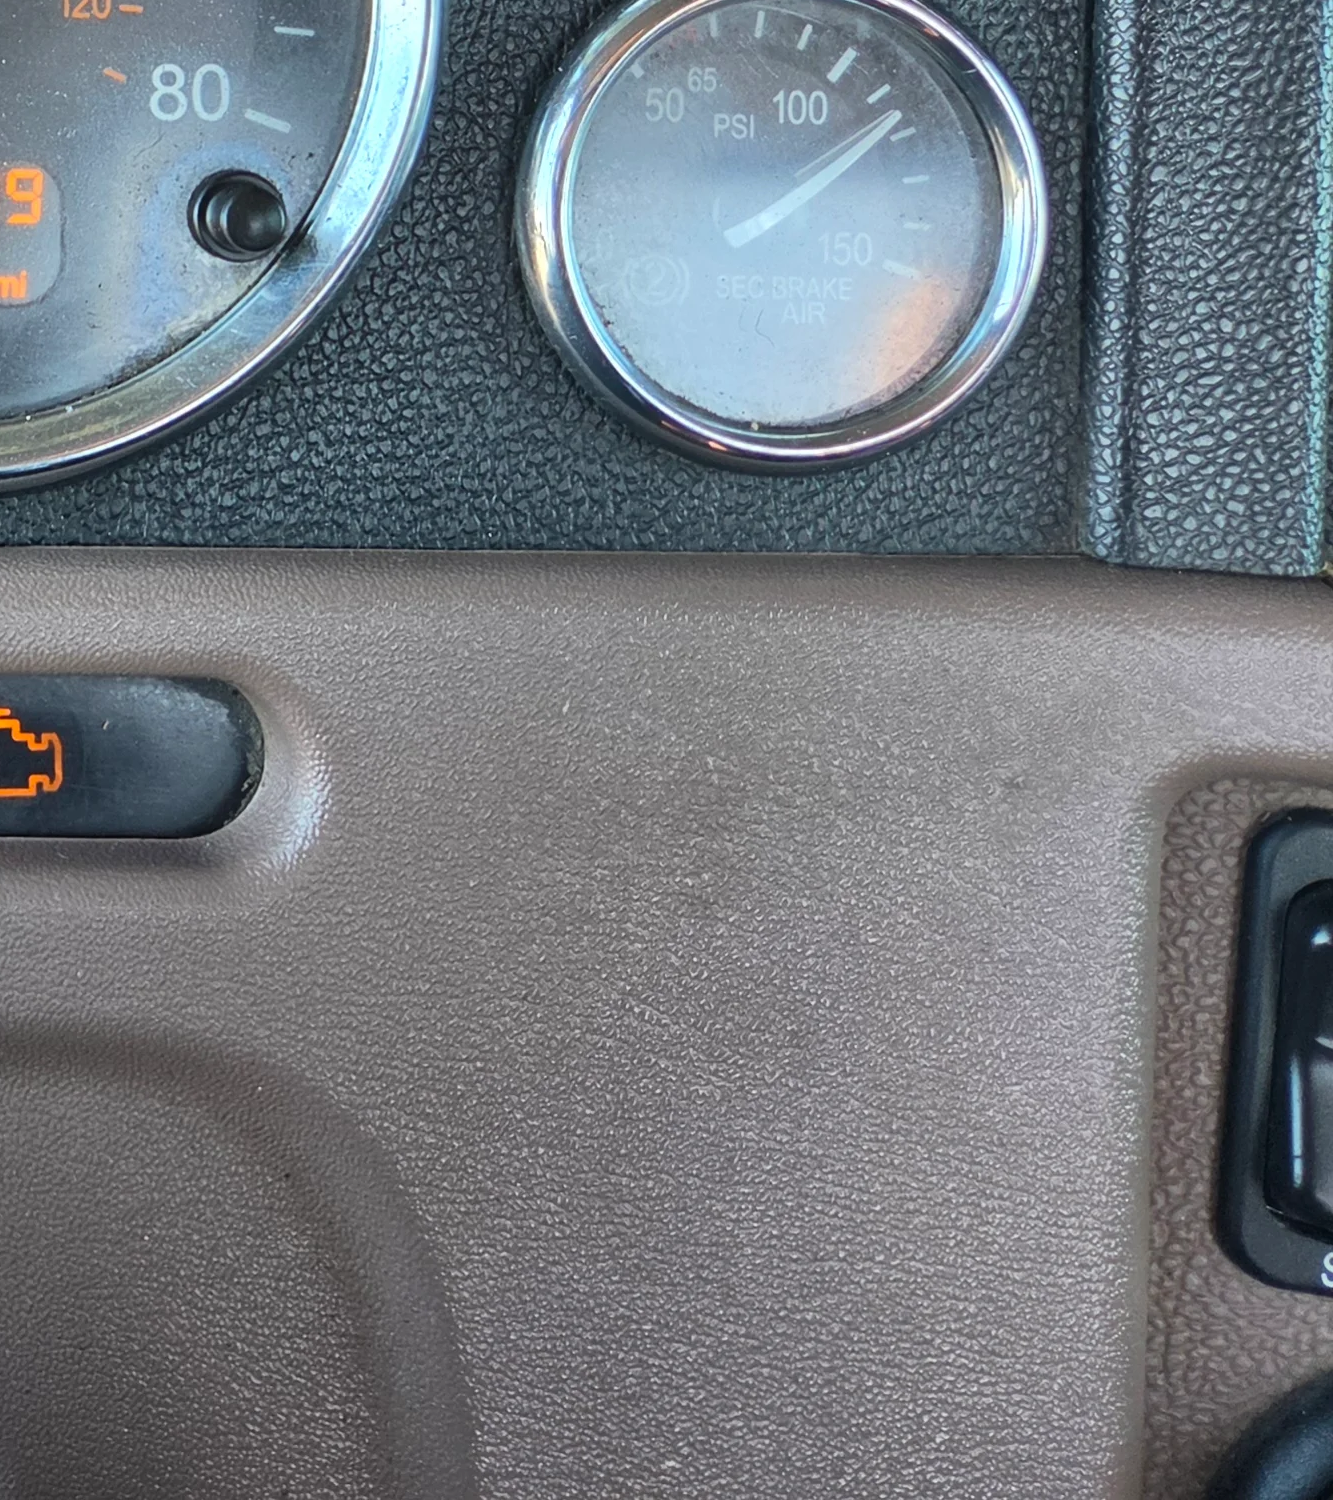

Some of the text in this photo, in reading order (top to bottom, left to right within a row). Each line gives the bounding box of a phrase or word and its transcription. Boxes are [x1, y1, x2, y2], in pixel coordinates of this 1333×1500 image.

[149, 62, 230, 121] 80
[687, 67, 717, 93] 65
[645, 87, 684, 123] 50
[772, 90, 828, 125] 100
[714, 113, 755, 140] PSI
[818, 232, 873, 266] 150
[716, 275, 854, 300] SEC BRAKE
[781, 302, 826, 325] AIR
